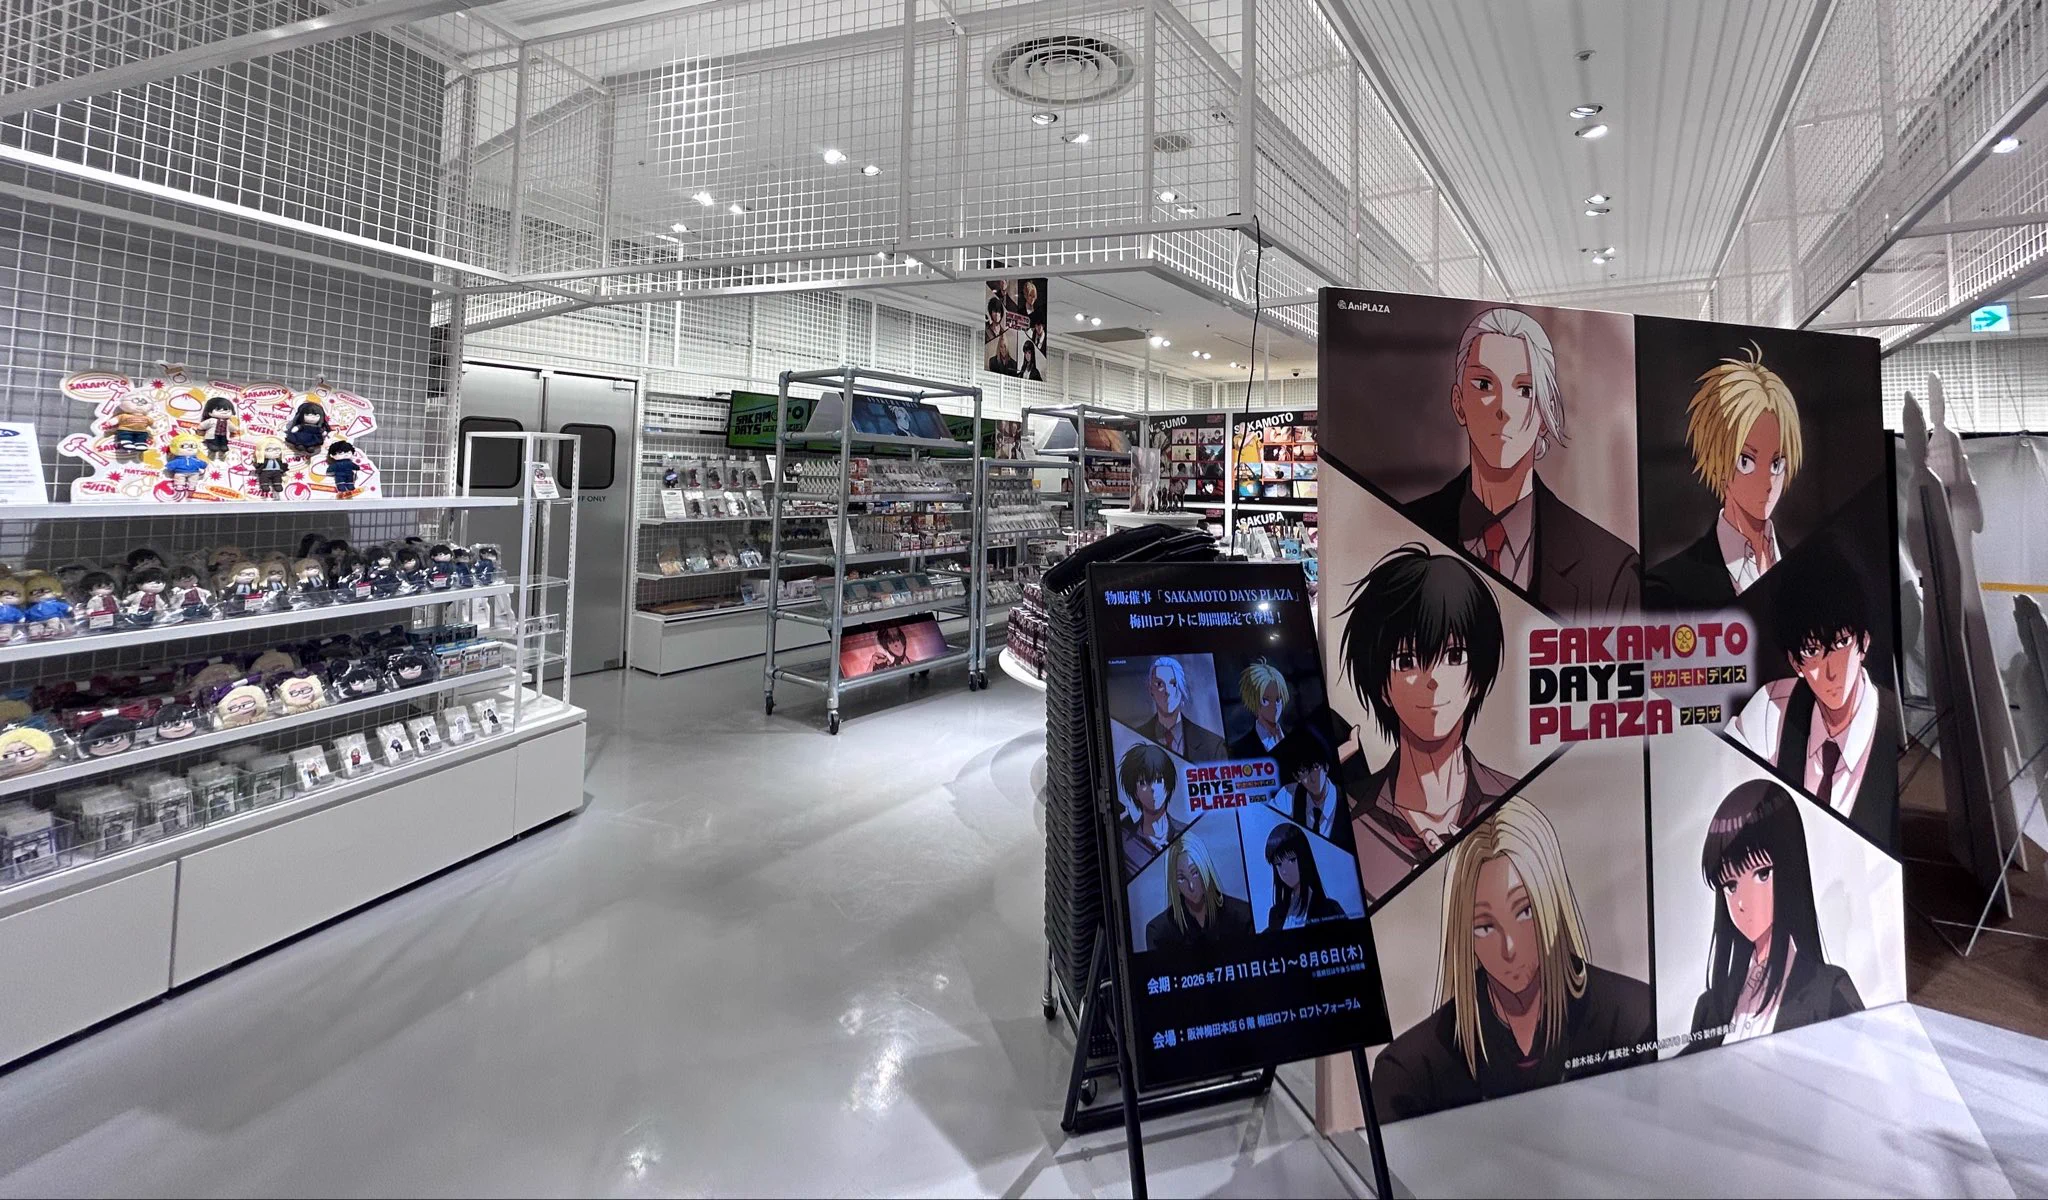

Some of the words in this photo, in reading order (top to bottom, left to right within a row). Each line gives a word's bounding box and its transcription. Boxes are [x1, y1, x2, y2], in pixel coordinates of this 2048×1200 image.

[1348, 301, 1390, 313] AniPLAZA
[736, 406, 804, 425] SAKAMOO
[1233, 412, 1294, 434] SKAMOTO
[734, 424, 762, 435] DAYS
[1230, 589, 1258, 602] DAYS
[1529, 621, 1748, 666] SAKAMOTO
[1529, 662, 1645, 705] DAYS
[1651, 665, 1747, 689] サカモトデイズ
[1529, 699, 1673, 745] PLAZA
[1680, 705, 1721, 726] プラザ
[1186, 762, 1275, 782] SAKAMOTO
[1187, 780, 1234, 797] DAYS
[1189, 793, 1248, 812] PLAZA
